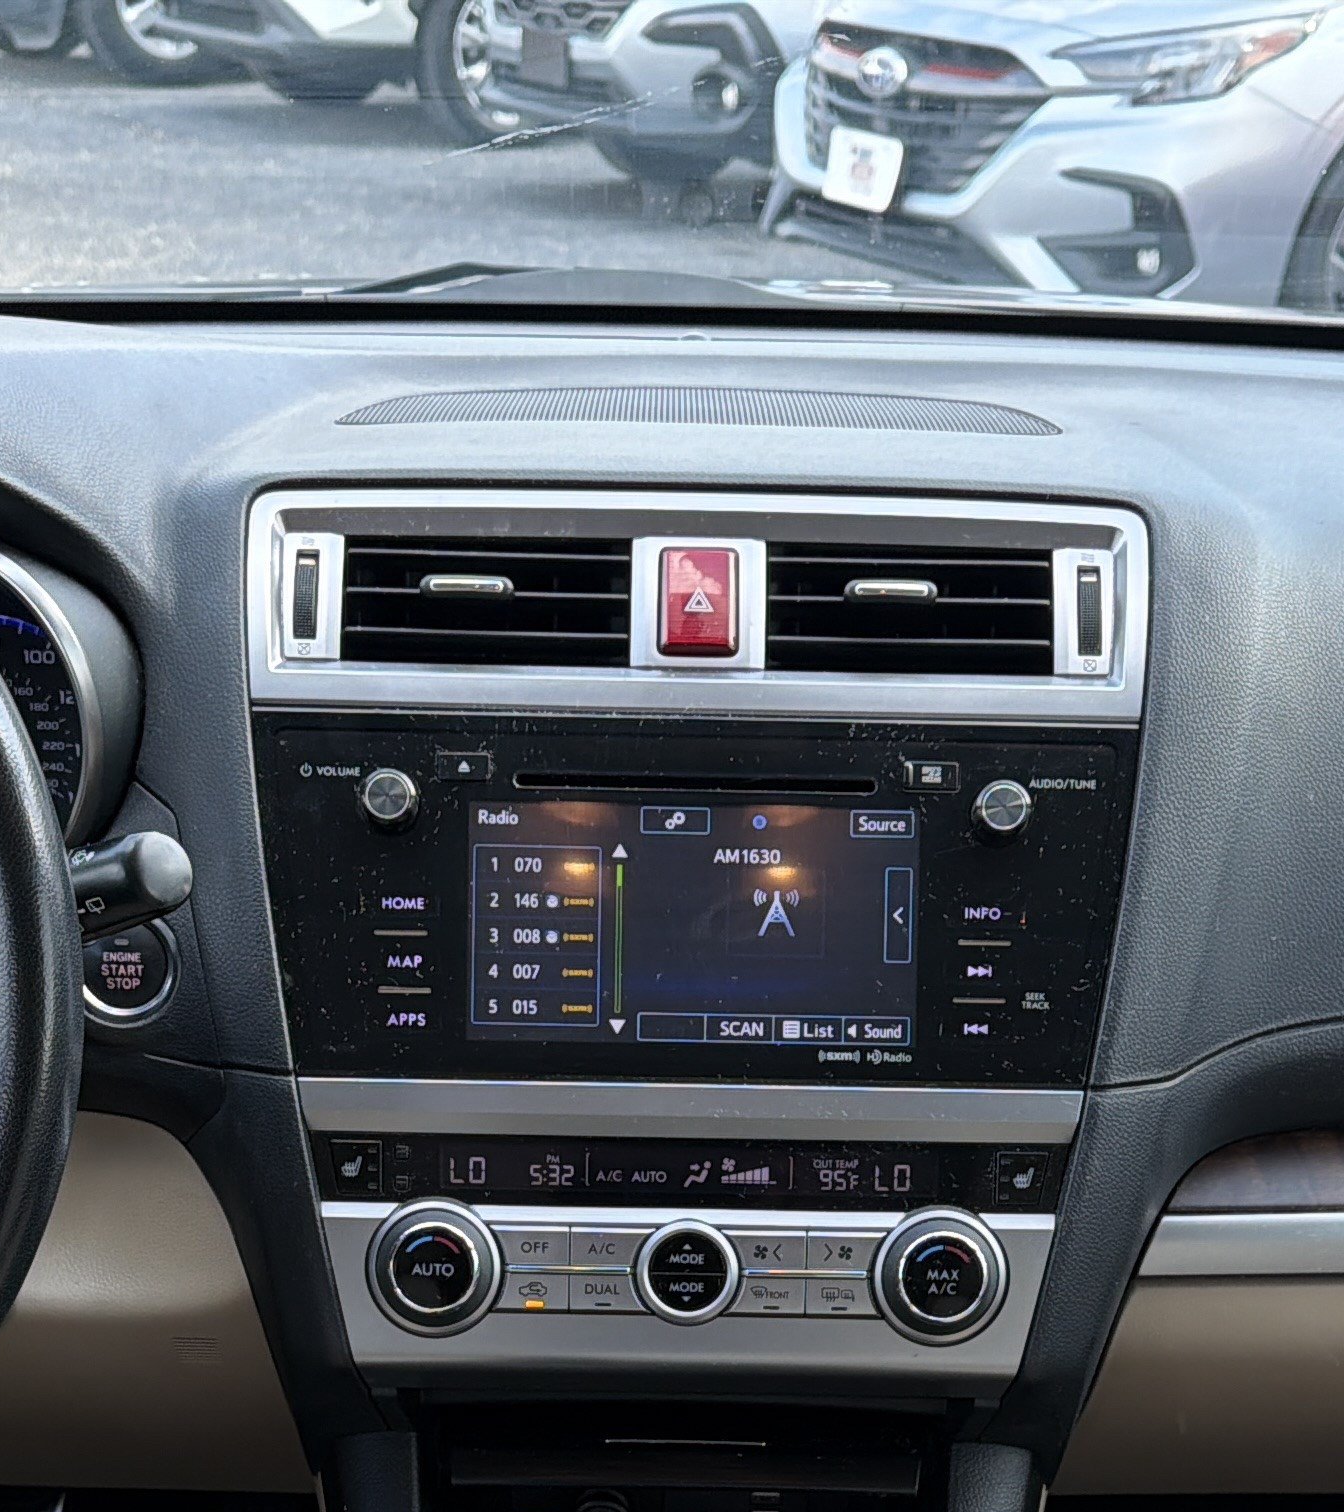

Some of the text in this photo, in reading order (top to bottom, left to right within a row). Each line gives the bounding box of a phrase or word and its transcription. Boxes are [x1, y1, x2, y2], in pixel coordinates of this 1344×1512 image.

[24, 650, 55, 664] 100
[14, 686, 33, 697] 160
[29, 702, 49, 712] 180
[37, 721, 59, 730] 200
[42, 741, 65, 750] 220
[316, 765, 360, 777] VOLUME
[1029, 778, 1096, 790] AUDIO/TUNE
[478, 809, 519, 825] Radio
[858, 816, 906, 832] Source
[713, 849, 781, 864] AM1630
[491, 857, 542, 873] 1 070
[381, 898, 425, 910] HOME
[490, 893, 499, 908] 2
[514, 893, 539, 909] 146
[964, 907, 1001, 920] INFO
[489, 928, 498, 943] 3
[513, 929, 540, 944] 008
[102, 952, 141, 962] ENGINE
[387, 955, 422, 968] MAP
[101, 964, 144, 977] START
[489, 964, 498, 979] 4
[513, 964, 540, 979] 007
[106, 978, 141, 989] STOP
[1024, 992, 1046, 1000] SEEK
[488, 1000, 498, 1014] 5
[512, 1000, 538, 1015] 015
[1021, 1001, 1050, 1010] TRACK
[387, 1014, 426, 1027] APPS
[719, 1022, 764, 1037] SCAN
[803, 1022, 834, 1038] List
[864, 1024, 902, 1039] Sound
[883, 1052, 912, 1063] Radio
[546, 1154, 560, 1163] PM
[813, 1158, 859, 1169] OUT TEMP
[530, 1164, 574, 1187] 5:32
[596, 1169, 667, 1183] A/C AUTO
[521, 1242, 549, 1254] OFF
[588, 1243, 616, 1255] A/C
[669, 1252, 705, 1265] MODE
[411, 1263, 454, 1277] AUTO
[927, 1269, 959, 1281] MAX
[584, 1283, 619, 1295] DUAL
[668, 1280, 705, 1293] MODE
[927, 1282, 957, 1295] A/C
[765, 1289, 790, 1299] FRONT
